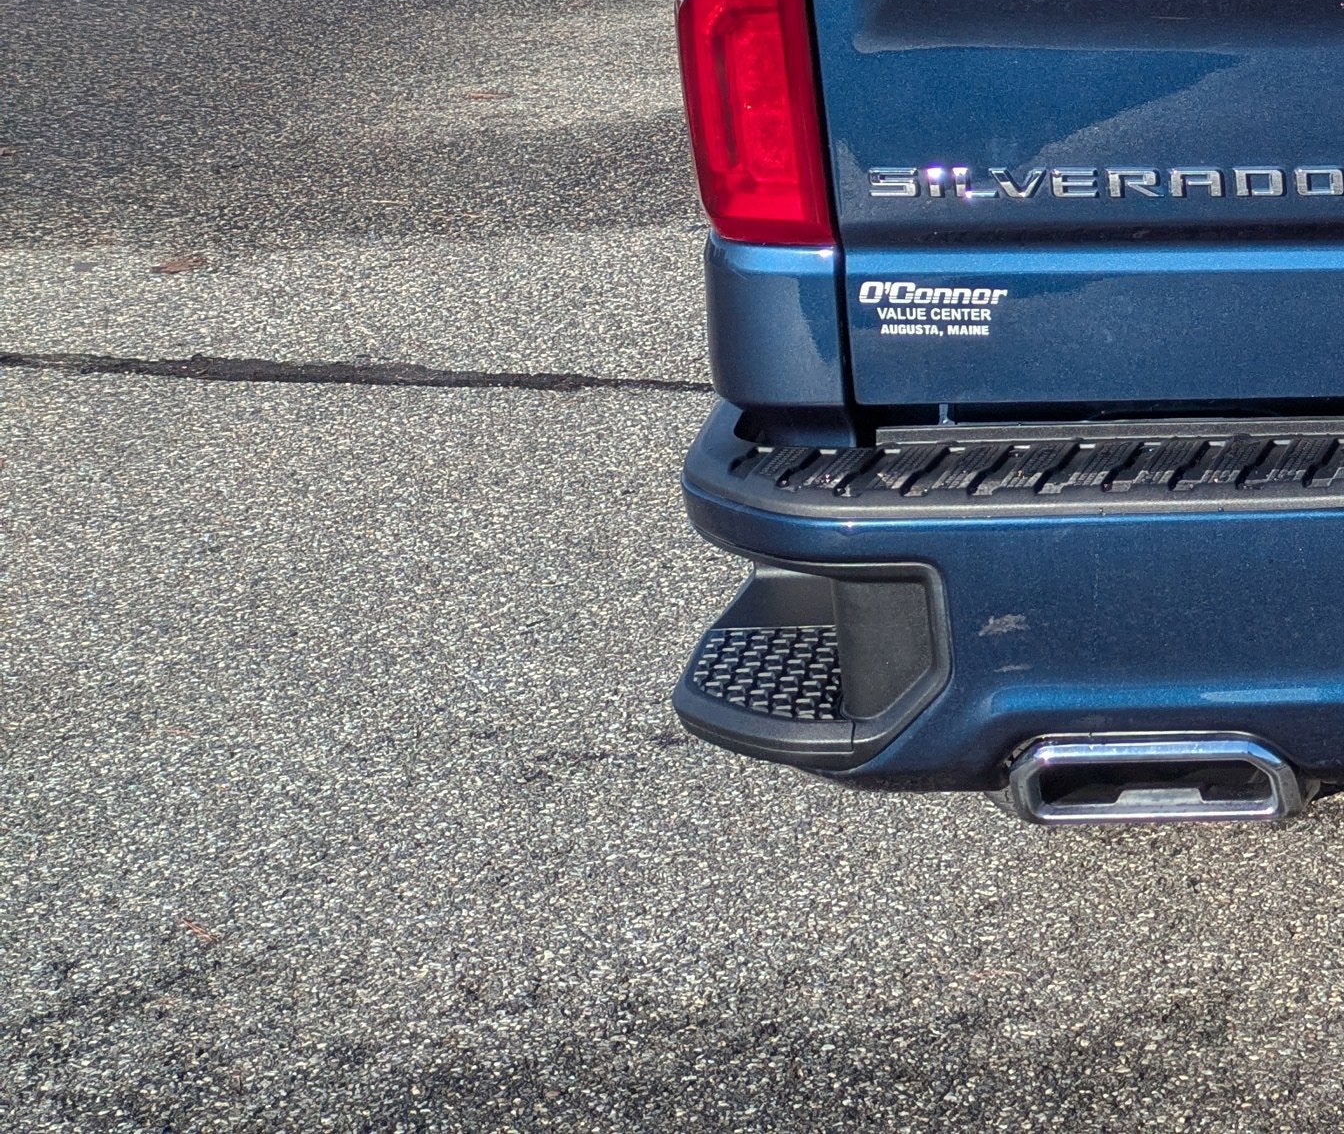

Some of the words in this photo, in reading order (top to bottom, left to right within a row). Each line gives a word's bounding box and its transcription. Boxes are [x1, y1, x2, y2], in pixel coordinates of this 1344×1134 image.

[859, 281, 1008, 305] O'Connor
[877, 307, 926, 320] VALUE
[930, 308, 991, 321] CENTER
[880, 324, 943, 337] AUGUSTA,
[947, 325, 989, 336] MAINE
